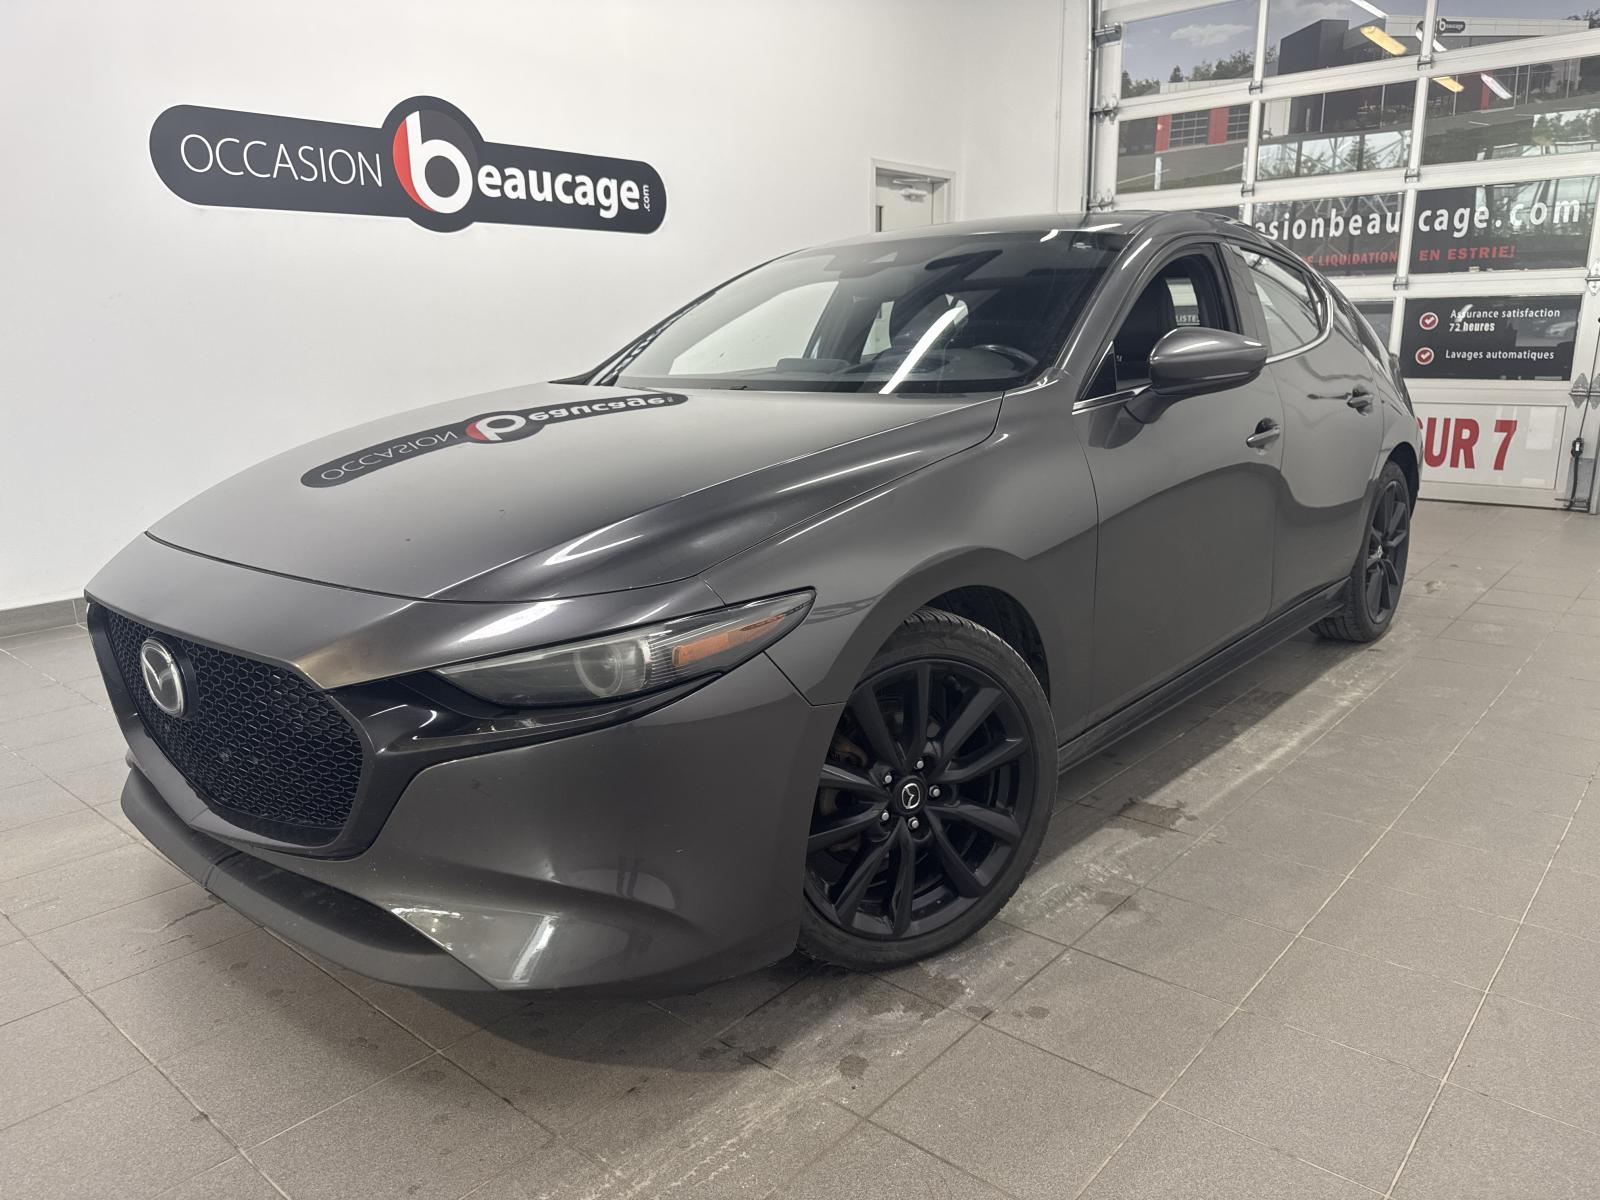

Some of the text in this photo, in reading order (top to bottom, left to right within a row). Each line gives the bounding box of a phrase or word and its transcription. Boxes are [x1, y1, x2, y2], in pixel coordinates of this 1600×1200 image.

[180, 110, 651, 219] OCCASION beaucage .com
[1318, 251, 1398, 267] LIQUIDATION
[1418, 250, 1440, 262] EN
[1447, 246, 1516, 260] ESTRIE!
[1450, 308, 1561, 319] Assurance satisfaction
[1449, 321, 1495, 332] 72 heures
[1445, 350, 1554, 361] Lavages automatiques
[1417, 416, 1518, 471] UR 7
